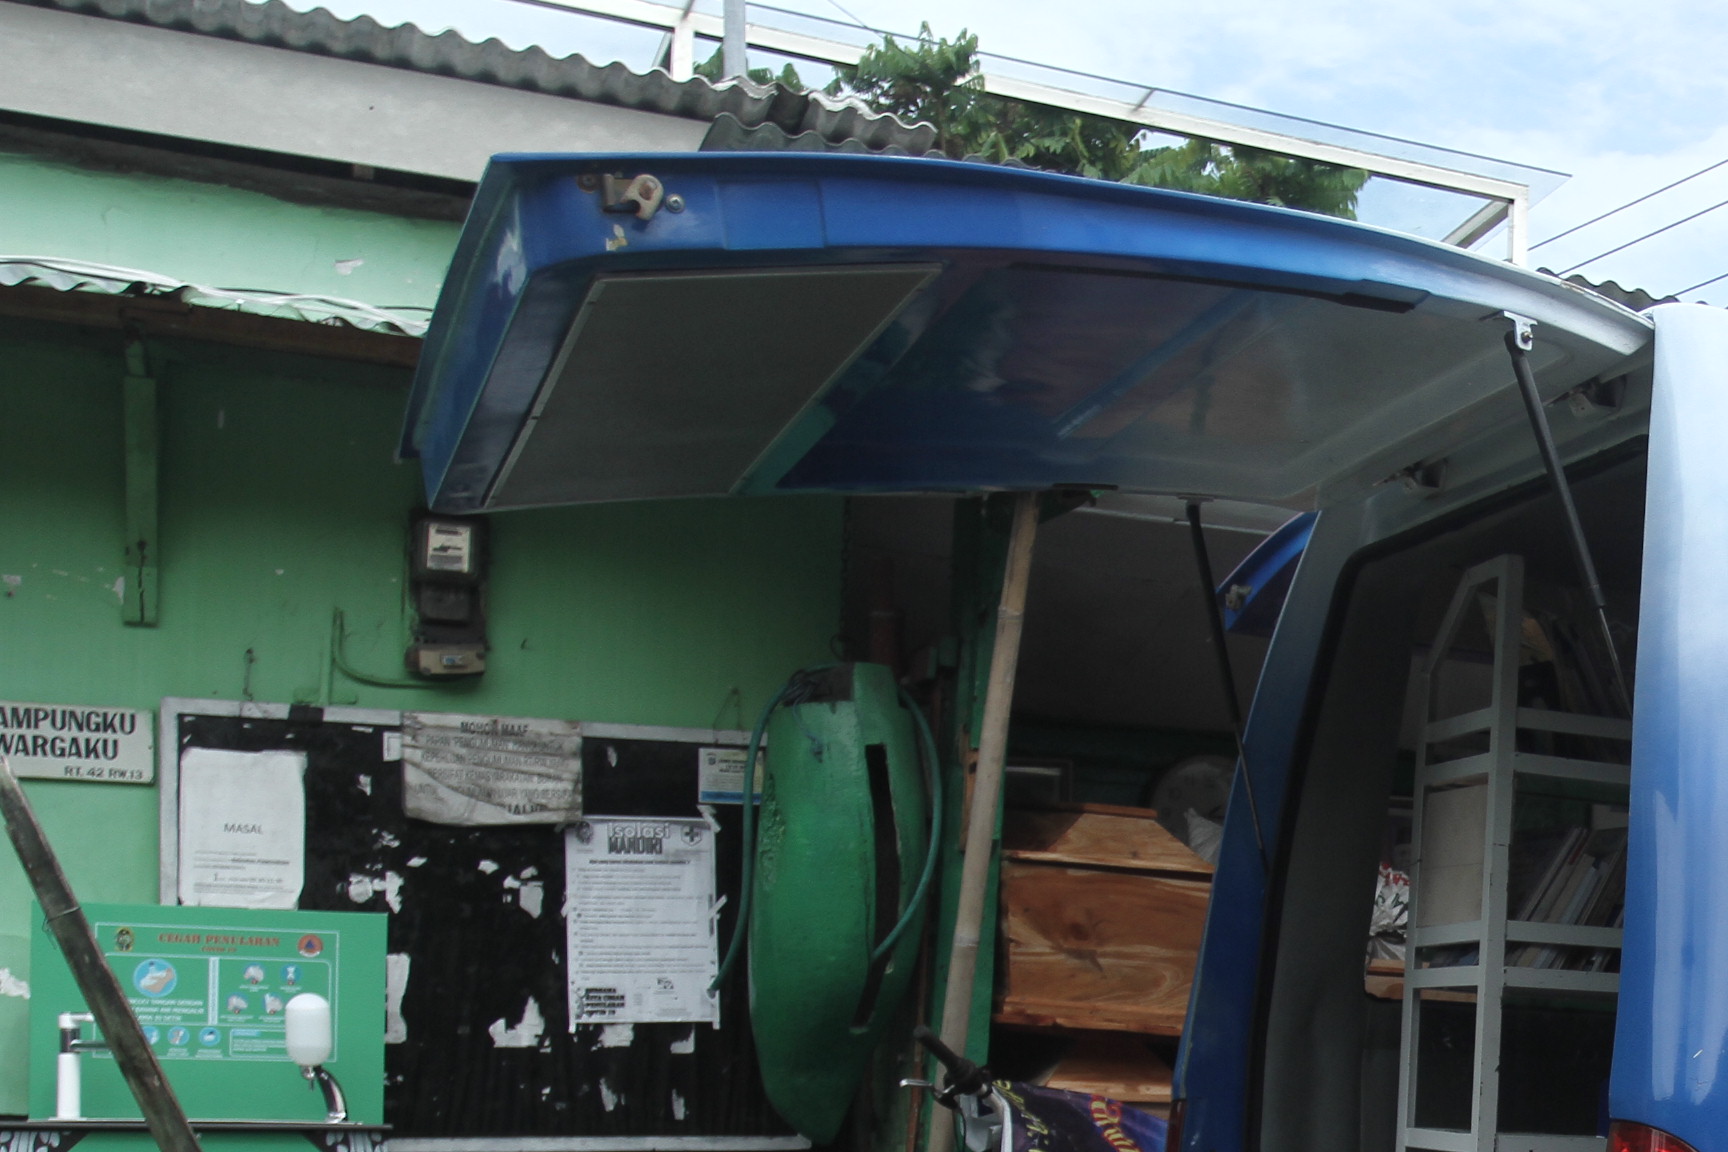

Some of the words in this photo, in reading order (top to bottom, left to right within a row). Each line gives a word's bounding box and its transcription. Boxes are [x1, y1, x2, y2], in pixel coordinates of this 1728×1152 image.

[0, 733, 119, 760] WARGAKU
[64, 765, 83, 777] RT.
[87, 767, 104, 779] 42
[608, 822, 670, 839] Isolasi
[608, 837, 663, 854] MANDIRI
